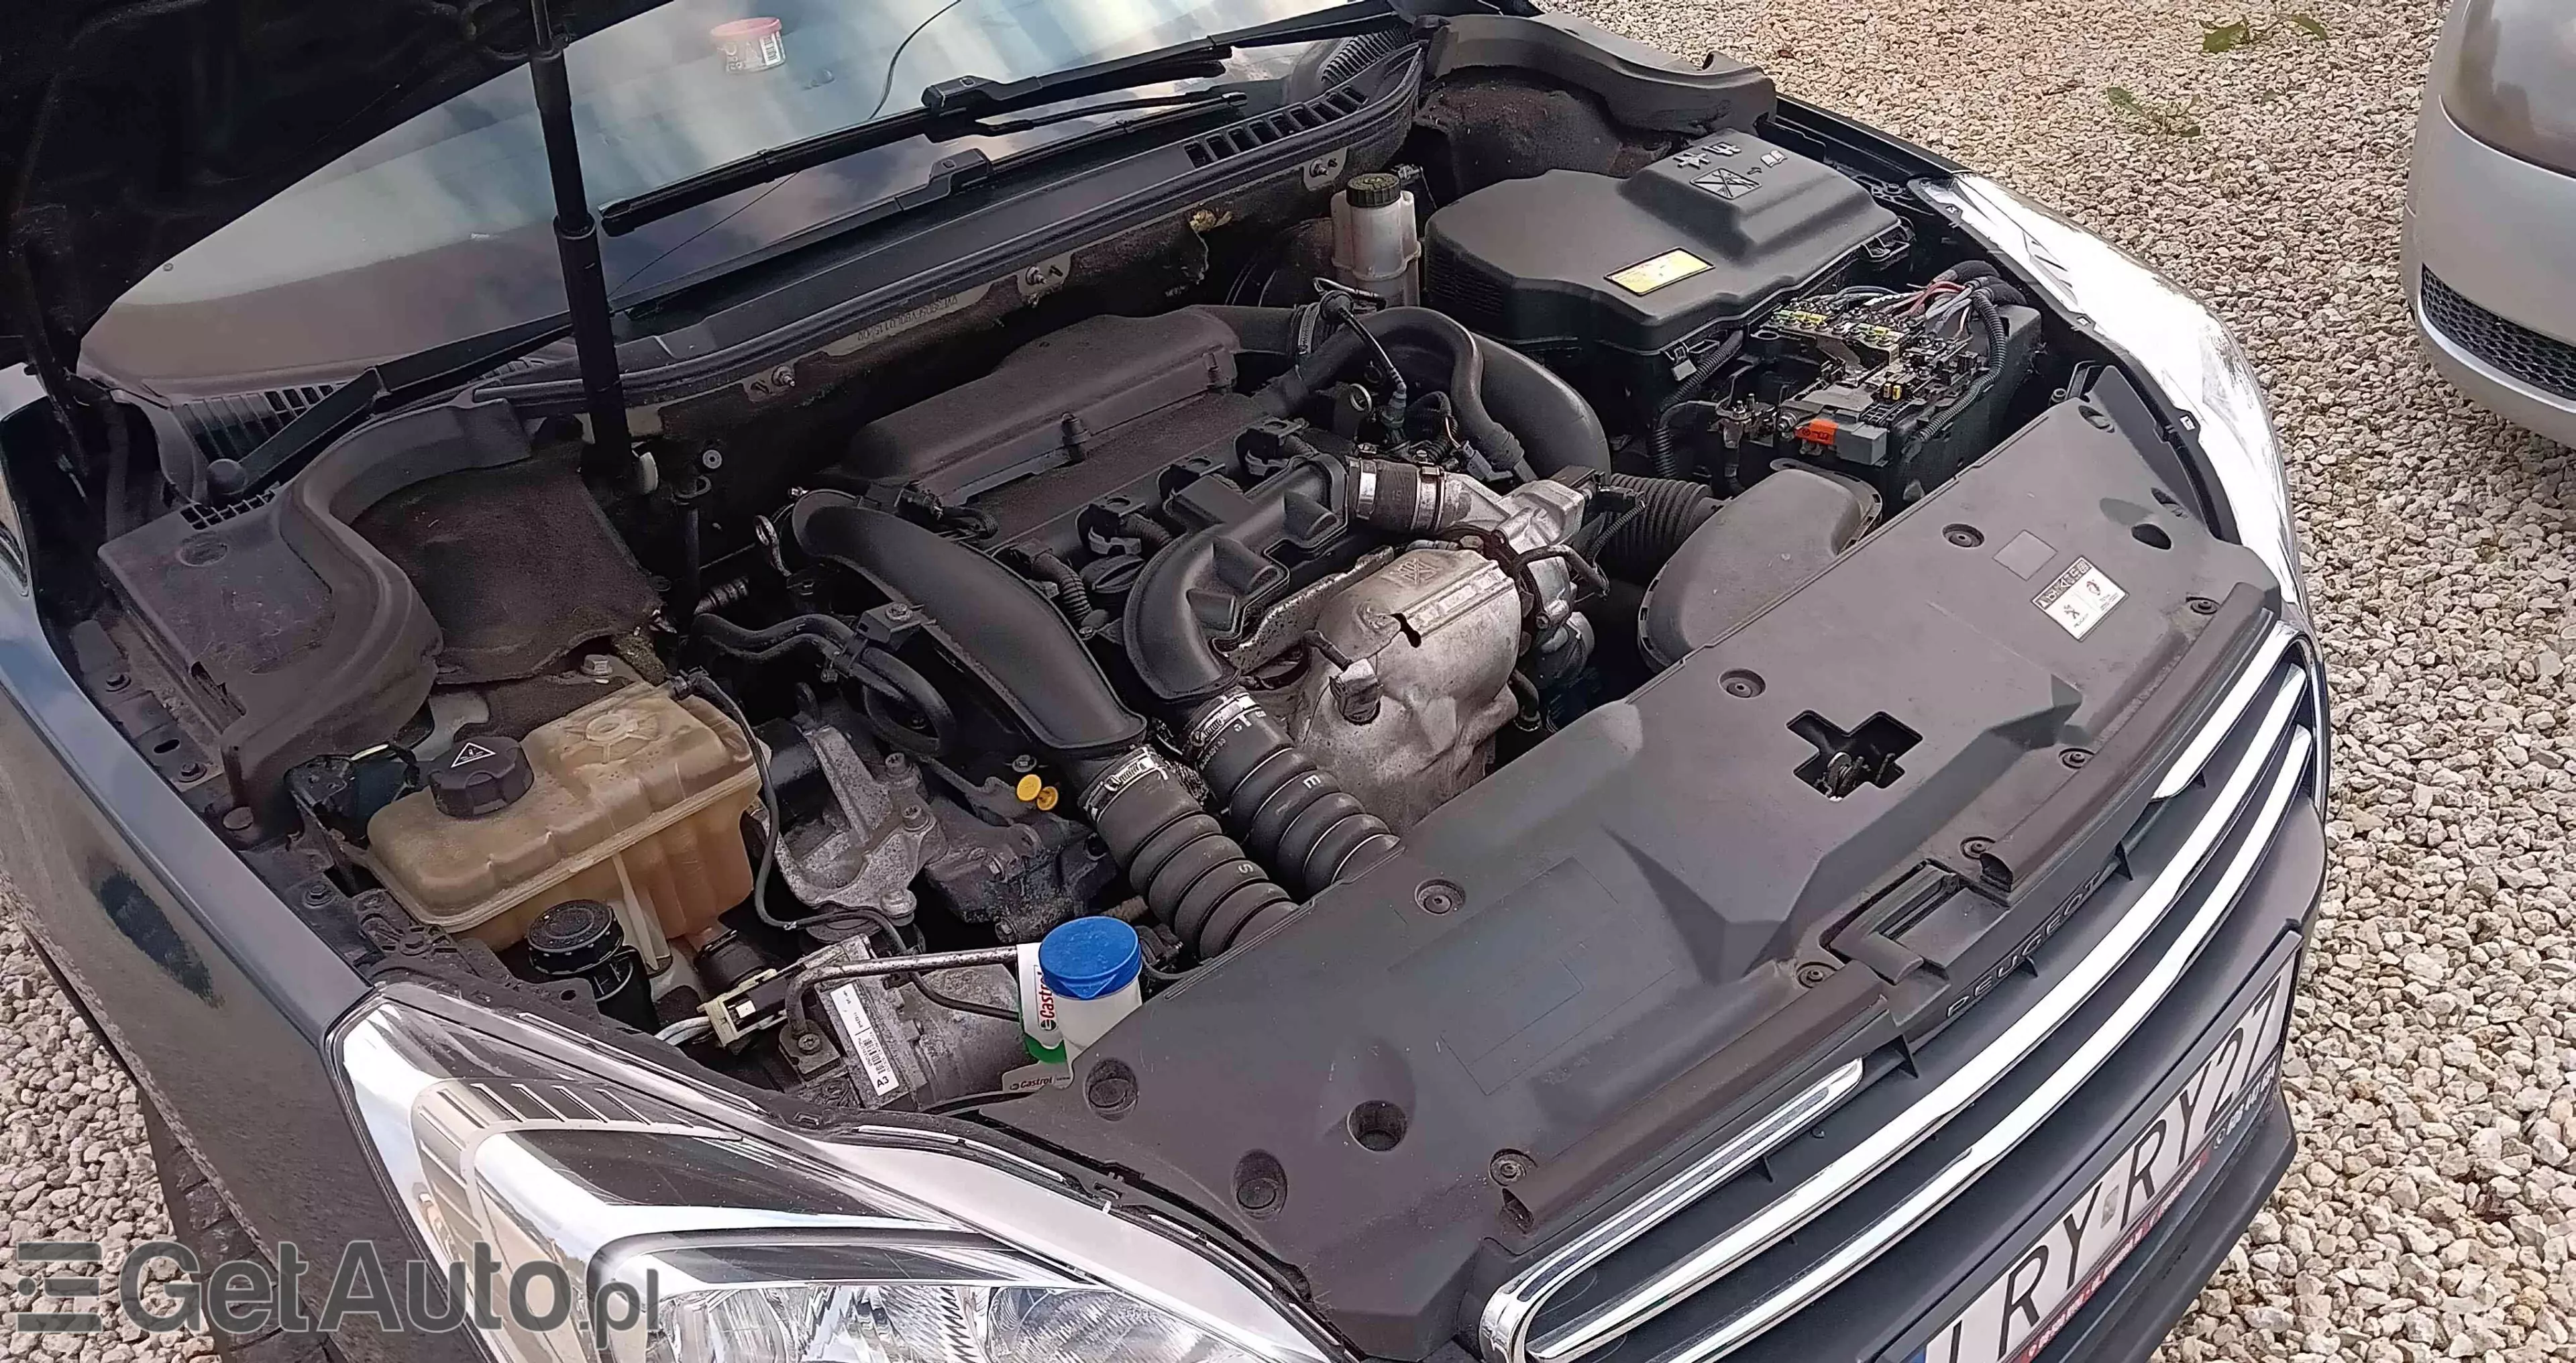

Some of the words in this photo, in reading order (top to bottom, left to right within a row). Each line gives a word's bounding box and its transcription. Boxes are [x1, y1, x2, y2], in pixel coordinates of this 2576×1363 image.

[1947, 871, 2101, 1018] PEUGEOT
[1037, 971, 1055, 1019] Castr
[877, 1076, 890, 1088] A3
[1020, 1077, 1053, 1088] Castrol
[2120, 973, 2280, 1232] RY27
